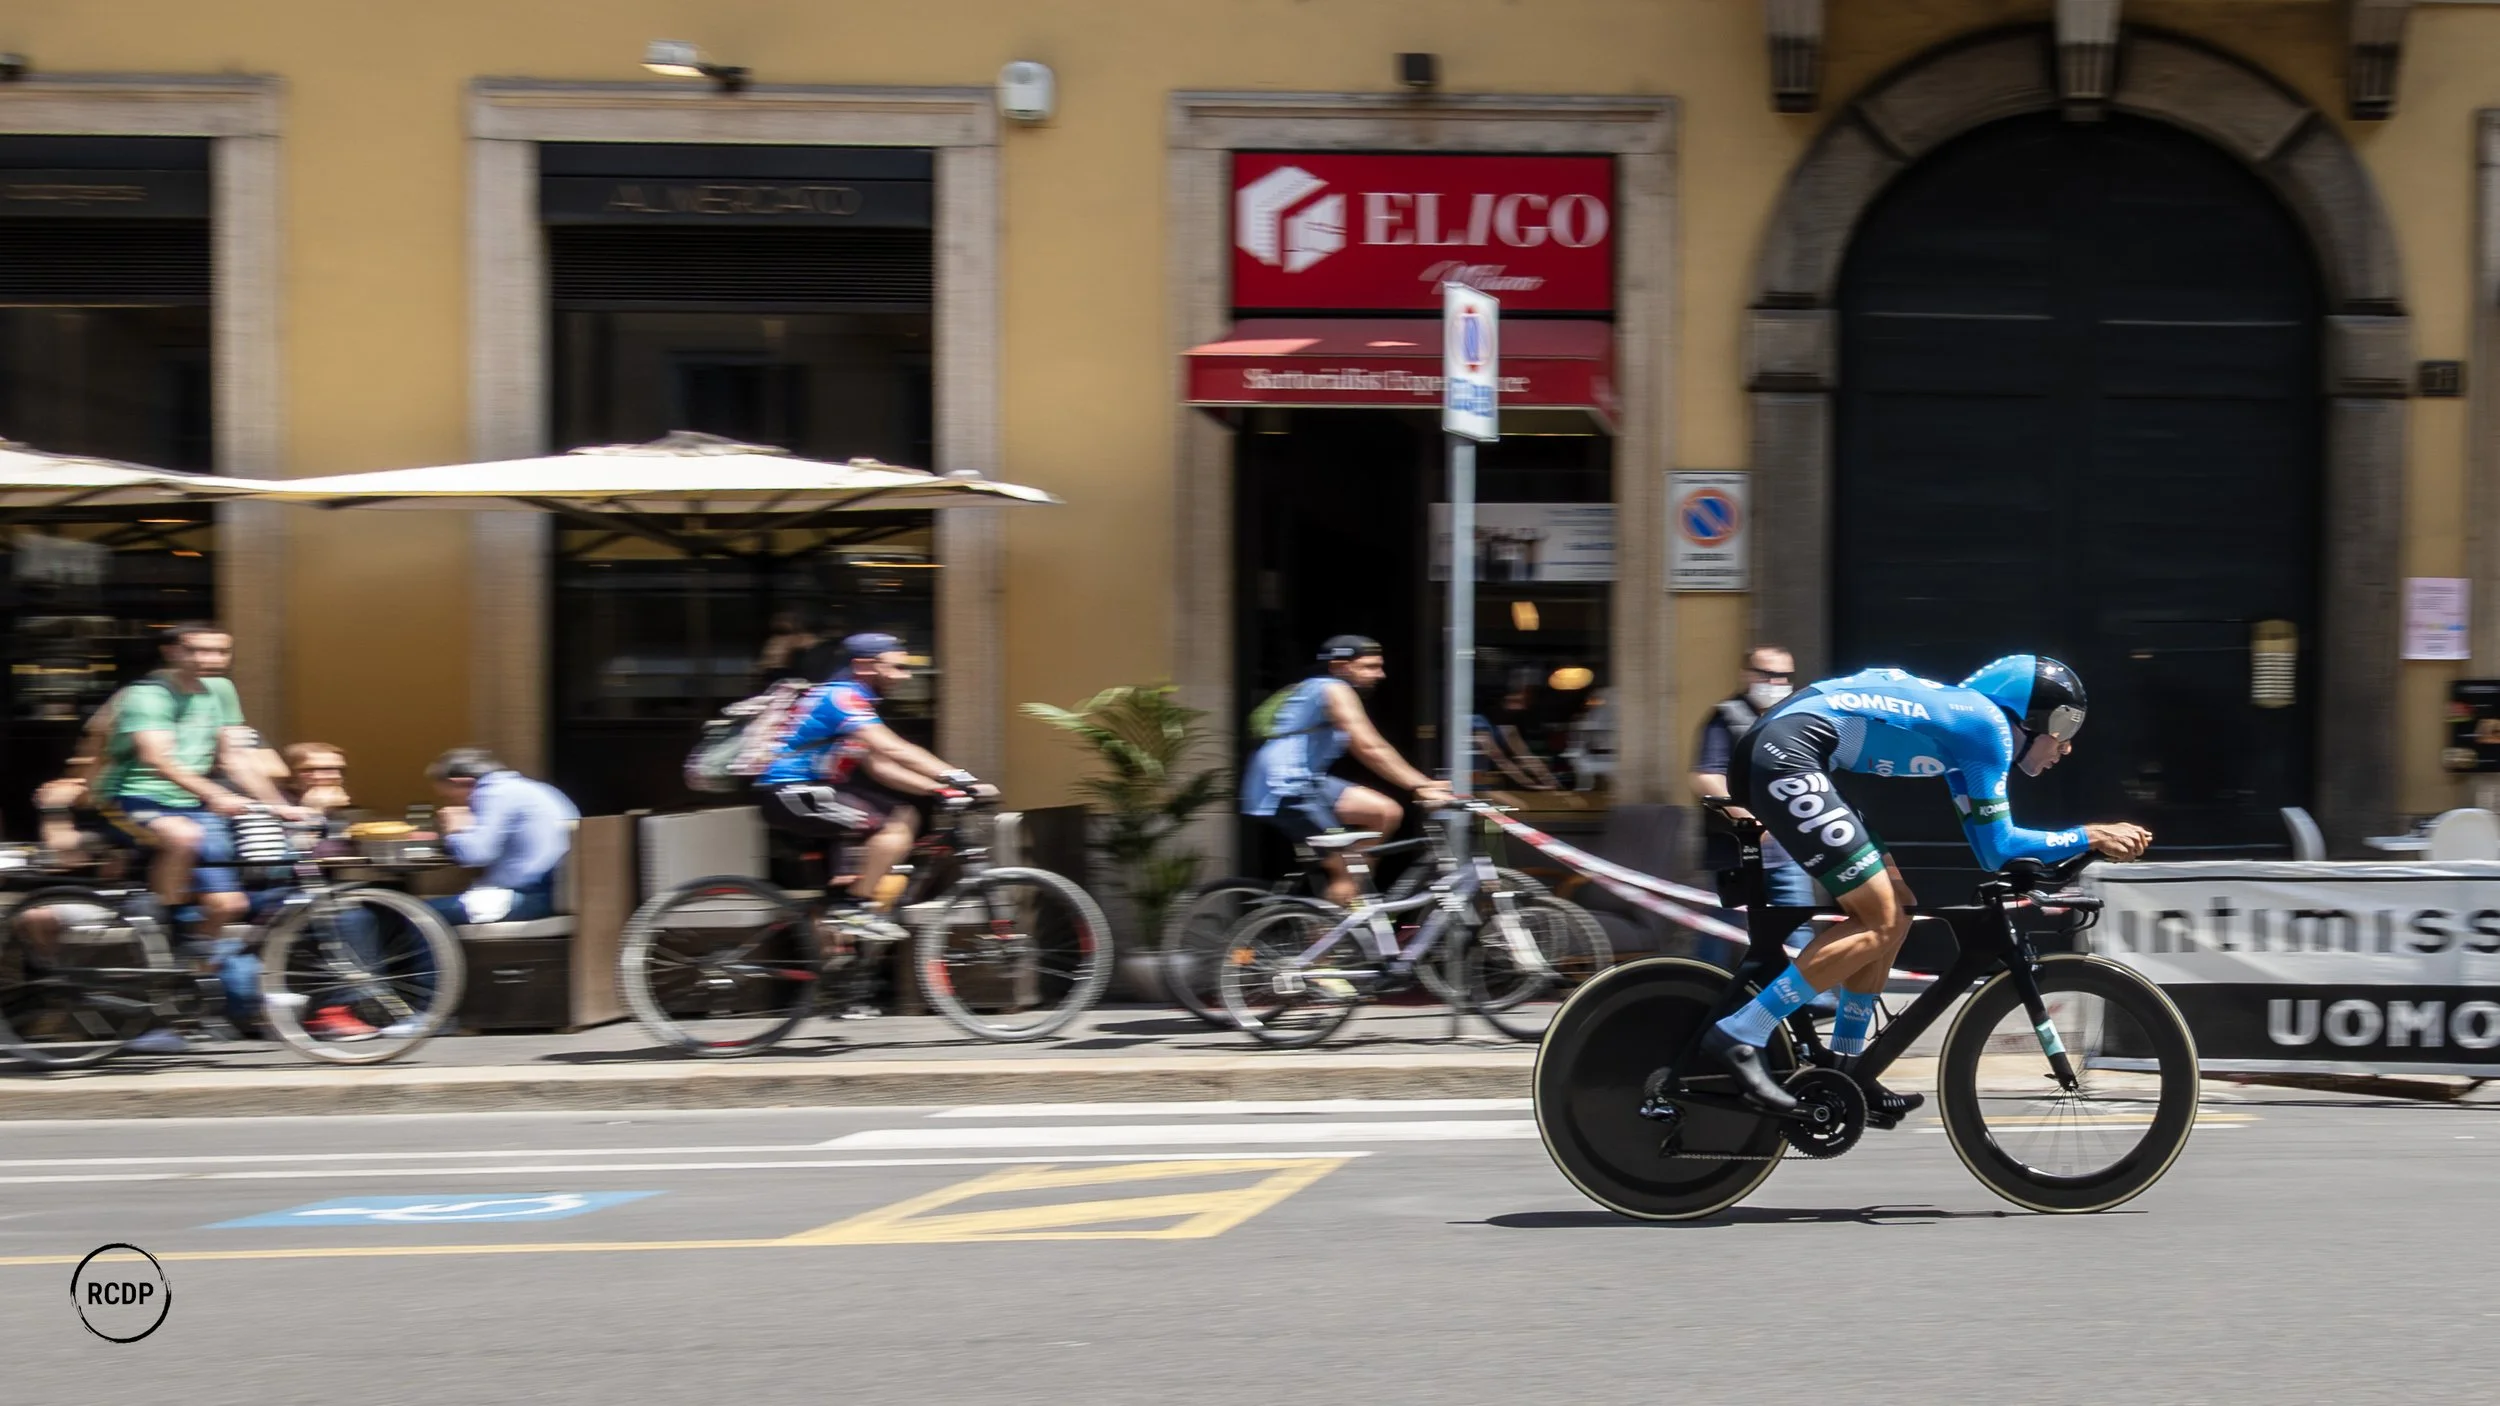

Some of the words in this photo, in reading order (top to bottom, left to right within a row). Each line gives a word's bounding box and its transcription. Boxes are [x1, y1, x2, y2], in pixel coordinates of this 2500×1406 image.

[1358, 192, 1610, 248] ELIGO
[1825, 693, 1931, 720] KOMETA
[1768, 772, 1856, 848] eolo
[2045, 832, 2079, 848] eolo
[2266, 998, 2500, 1049] UOMO
